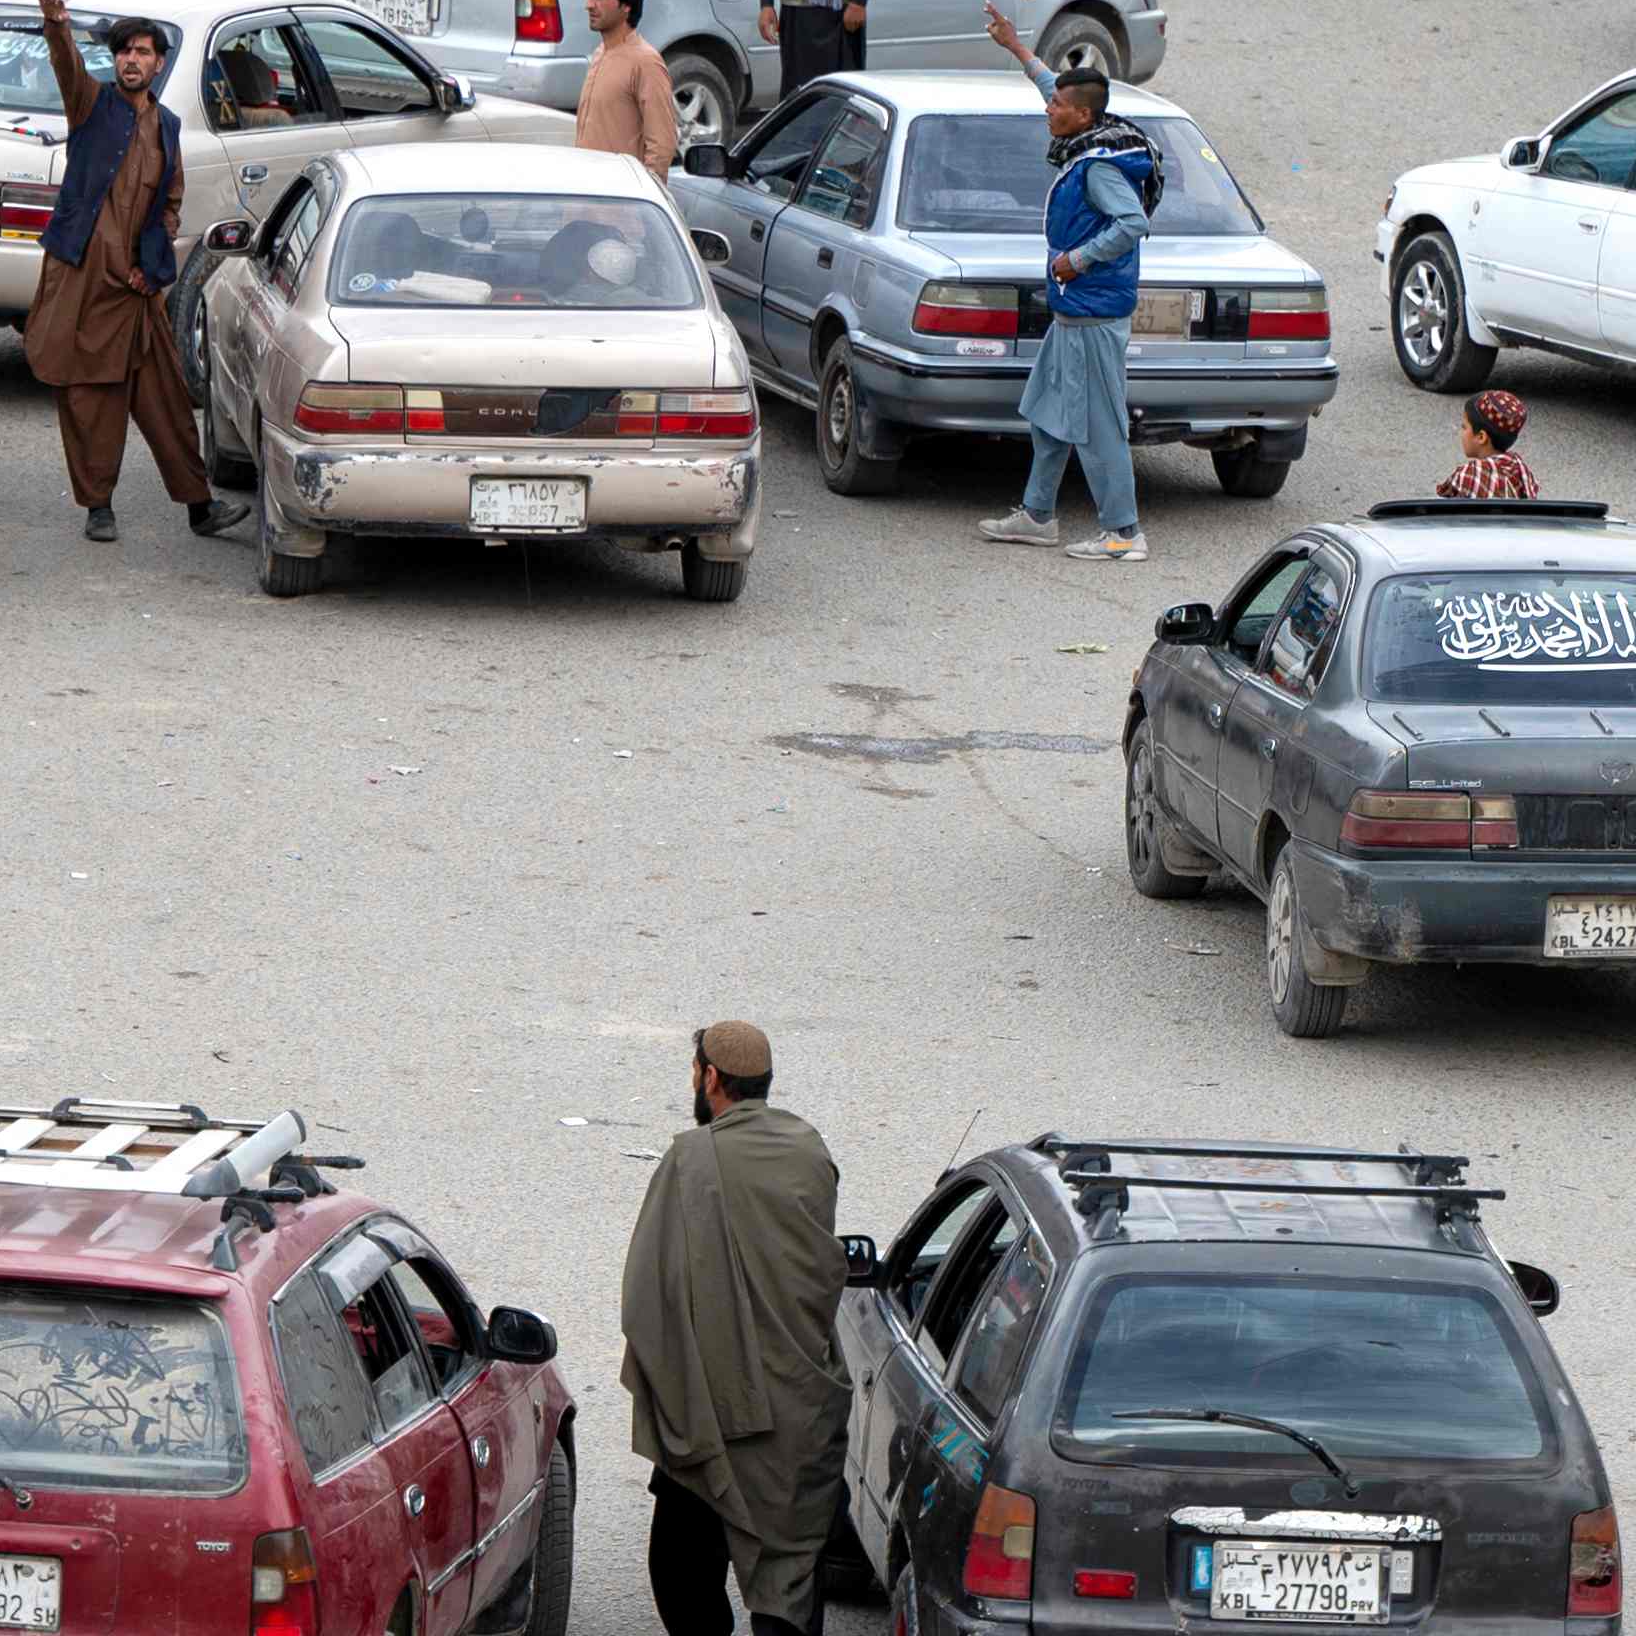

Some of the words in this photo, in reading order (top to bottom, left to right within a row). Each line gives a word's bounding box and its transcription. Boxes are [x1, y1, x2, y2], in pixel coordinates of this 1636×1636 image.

[1219, 1592, 1257, 1610] KBL
[1275, 1583, 1348, 1611] 27798
[33, 1607, 57, 1626] SH
